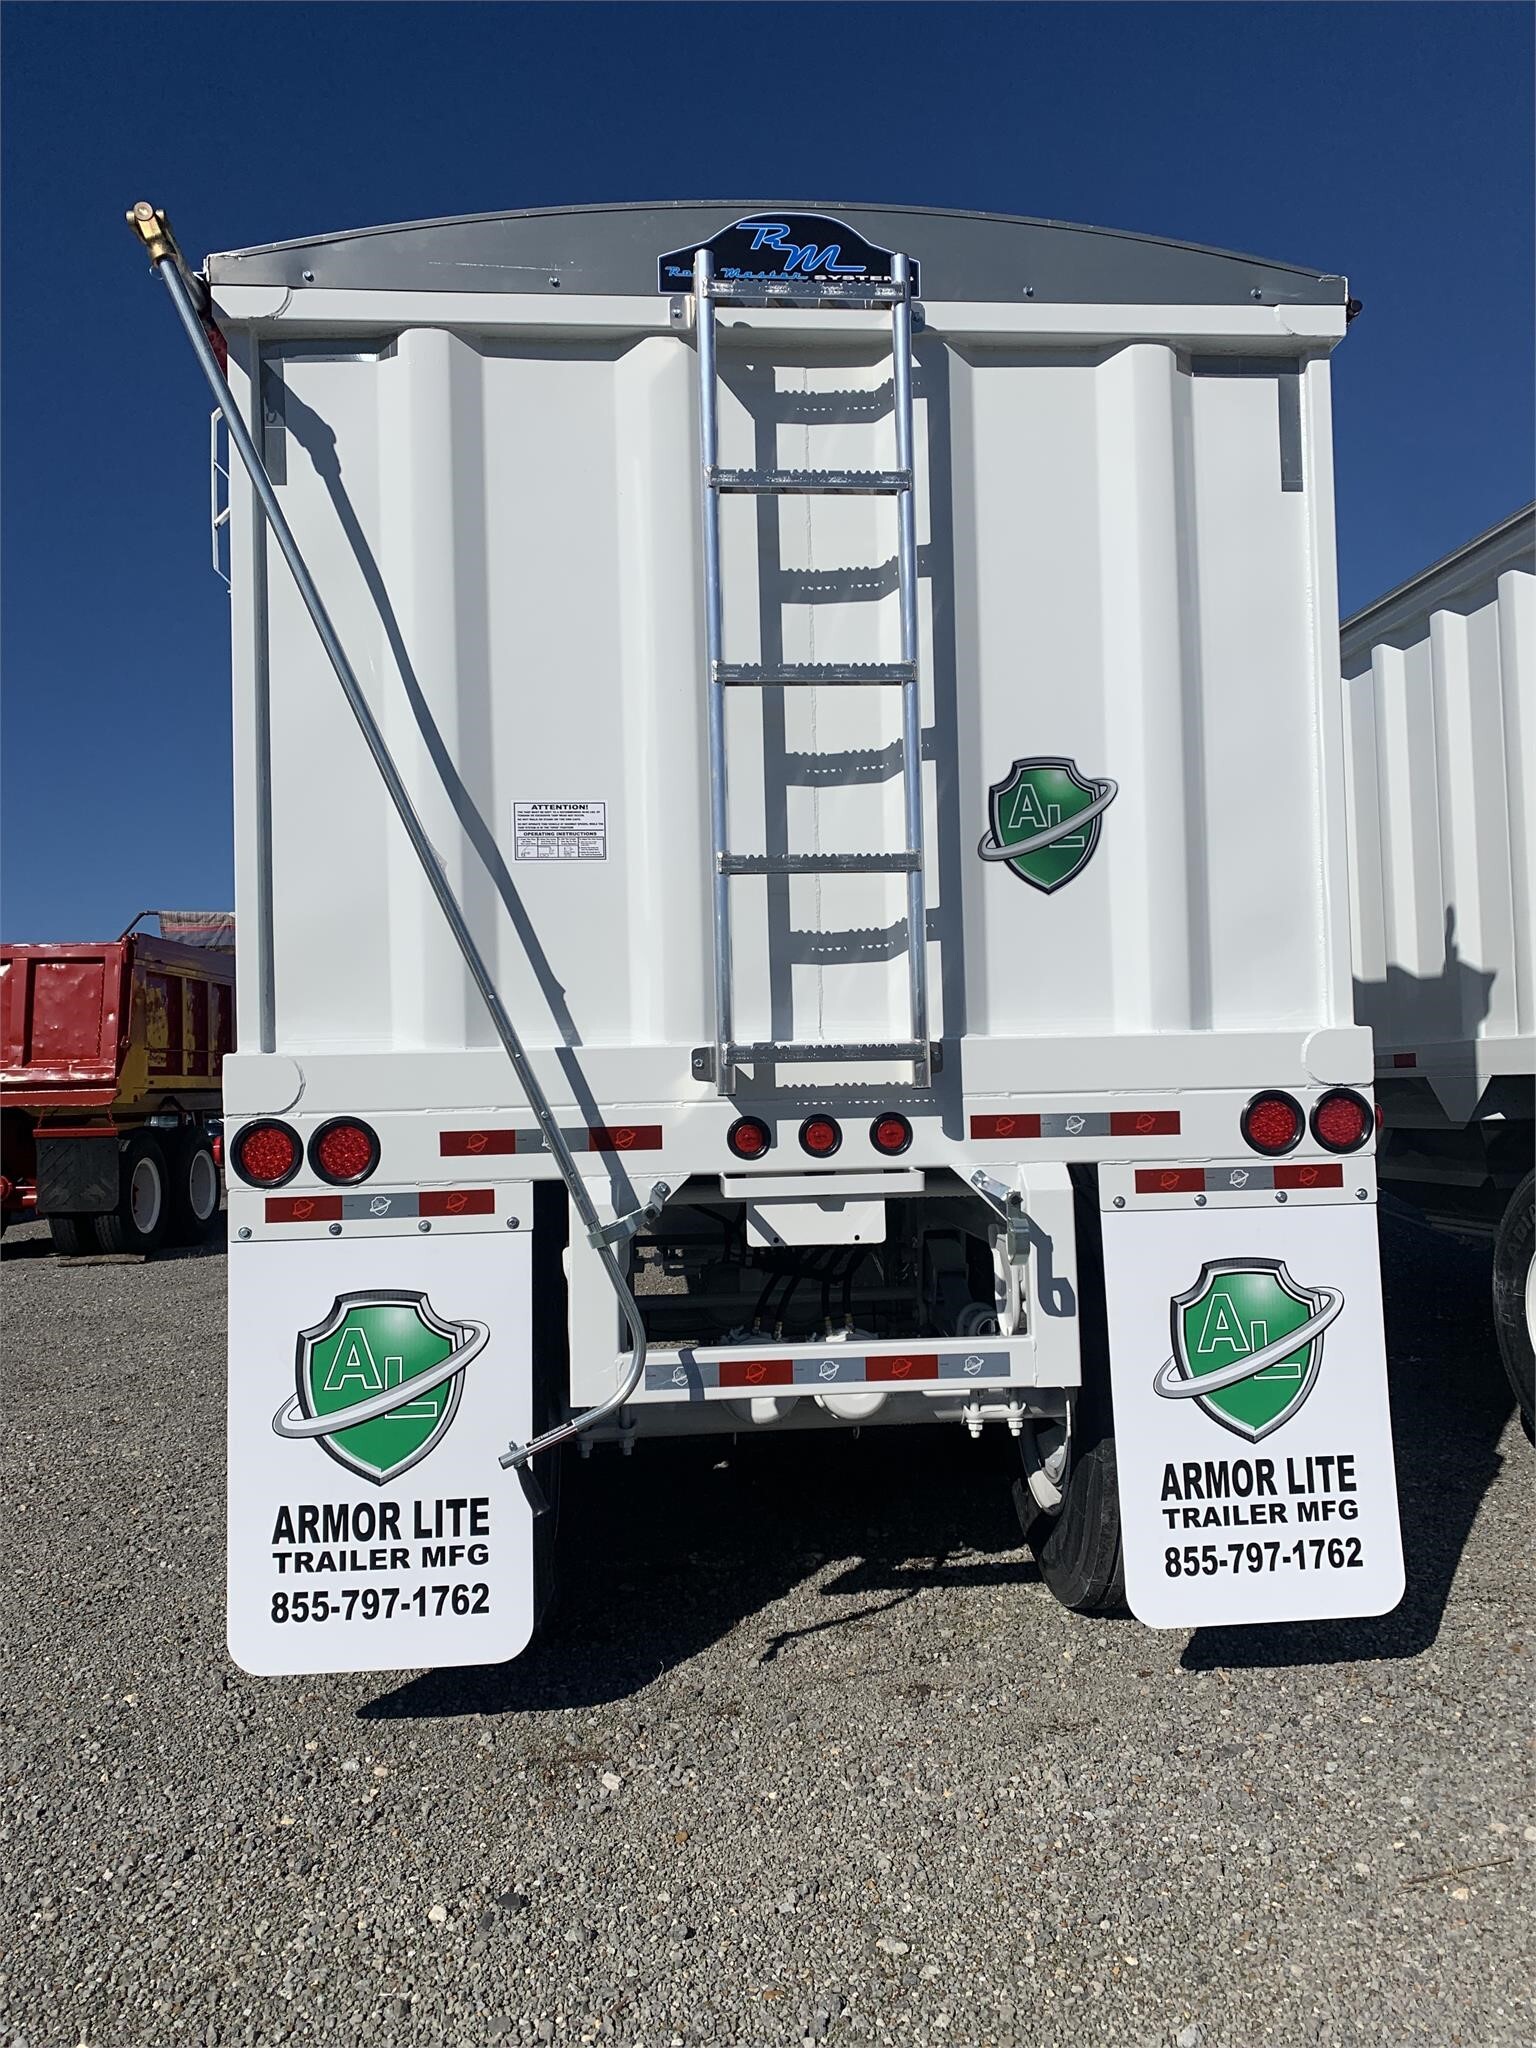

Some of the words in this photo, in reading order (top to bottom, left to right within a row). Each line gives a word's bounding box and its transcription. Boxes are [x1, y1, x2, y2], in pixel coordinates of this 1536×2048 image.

[736, 223, 866, 271] RM
[720, 268, 809, 279] Master
[1008, 783, 1085, 848] AL
[1197, 1293, 1302, 1380] AL
[323, 1327, 438, 1419] AL
[1160, 1458, 1278, 1501] ARMOR
[1286, 1454, 1358, 1495] LITE
[271, 1501, 402, 1545] ARMOR
[413, 1497, 490, 1540] LITE
[1162, 1503, 1289, 1530] TRAILER
[1297, 1499, 1359, 1522] MFG
[272, 1547, 411, 1574] TRAILER
[421, 1543, 490, 1568] MFG
[1164, 1537, 1364, 1578] 855-797-1762
[270, 1583, 490, 1624] 855-797-1762
